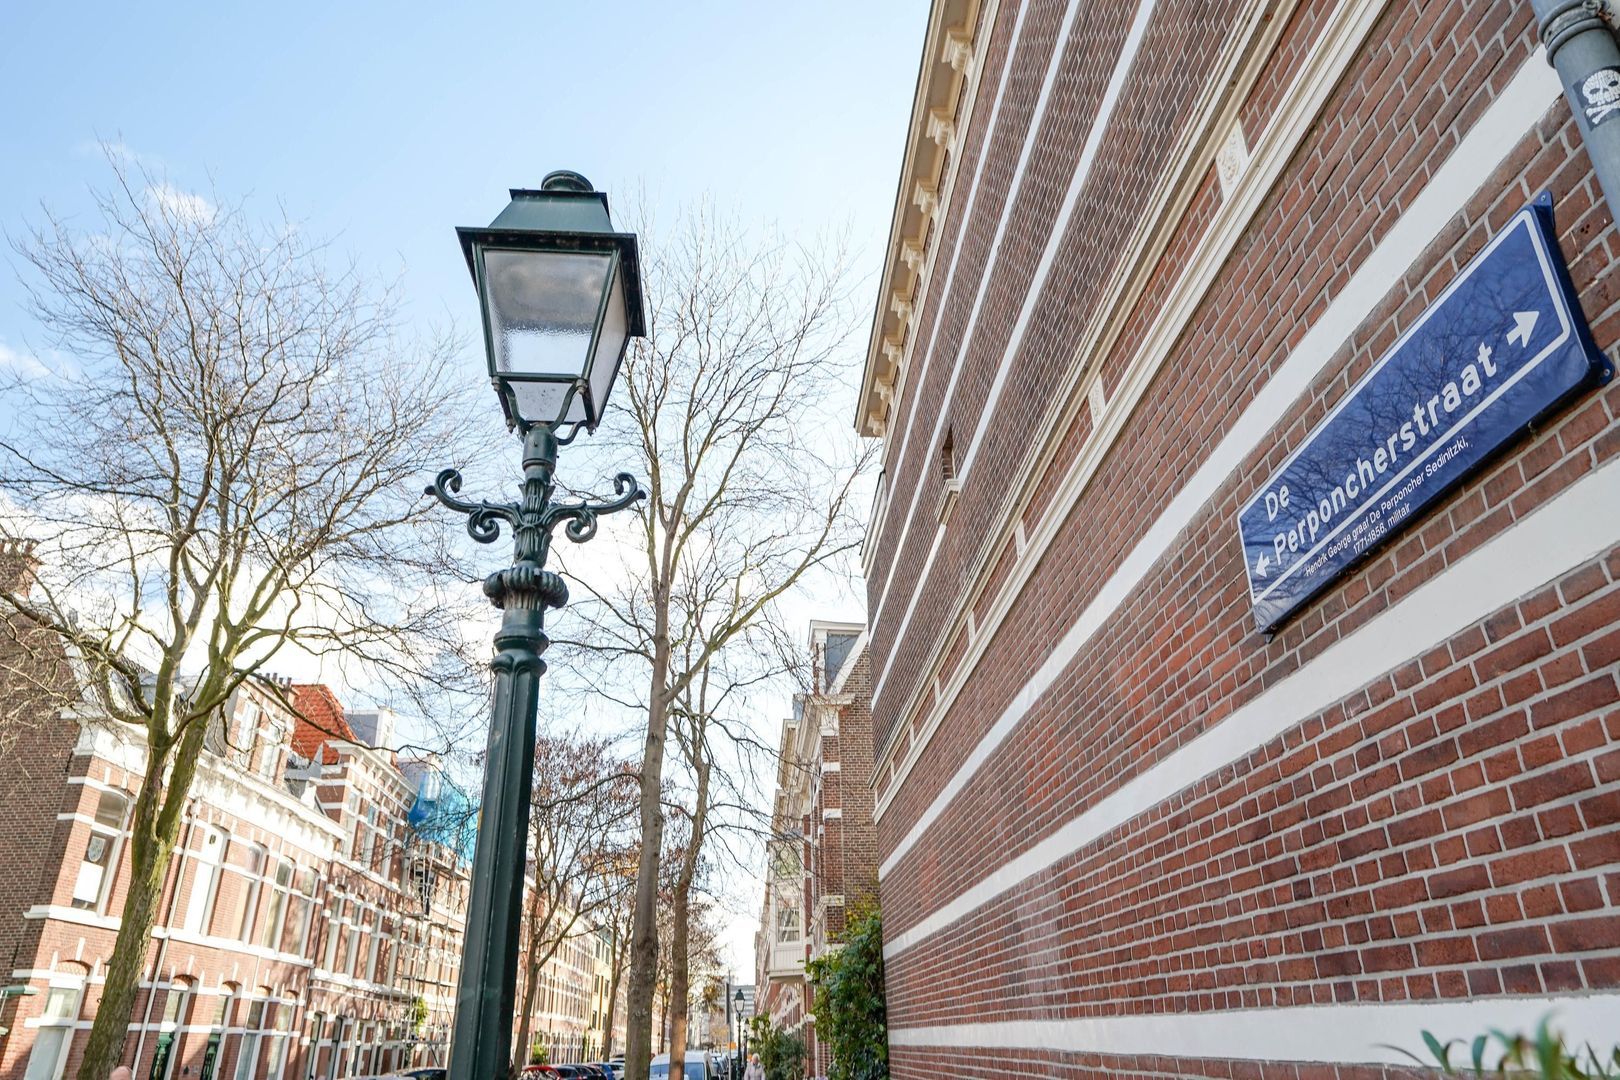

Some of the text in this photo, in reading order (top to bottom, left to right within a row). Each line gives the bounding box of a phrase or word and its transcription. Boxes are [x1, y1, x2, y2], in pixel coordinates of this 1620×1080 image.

[1273, 342, 1497, 565] Perponcherstraat
[1265, 485, 1289, 522] De
[1305, 553, 1328, 576] Hendrik
[1327, 534, 1351, 558] George
[1352, 516, 1369, 540] graaf
[1369, 510, 1381, 523] De
[1381, 472, 1425, 514] Perponcher
[1387, 502, 1410, 527] militair
